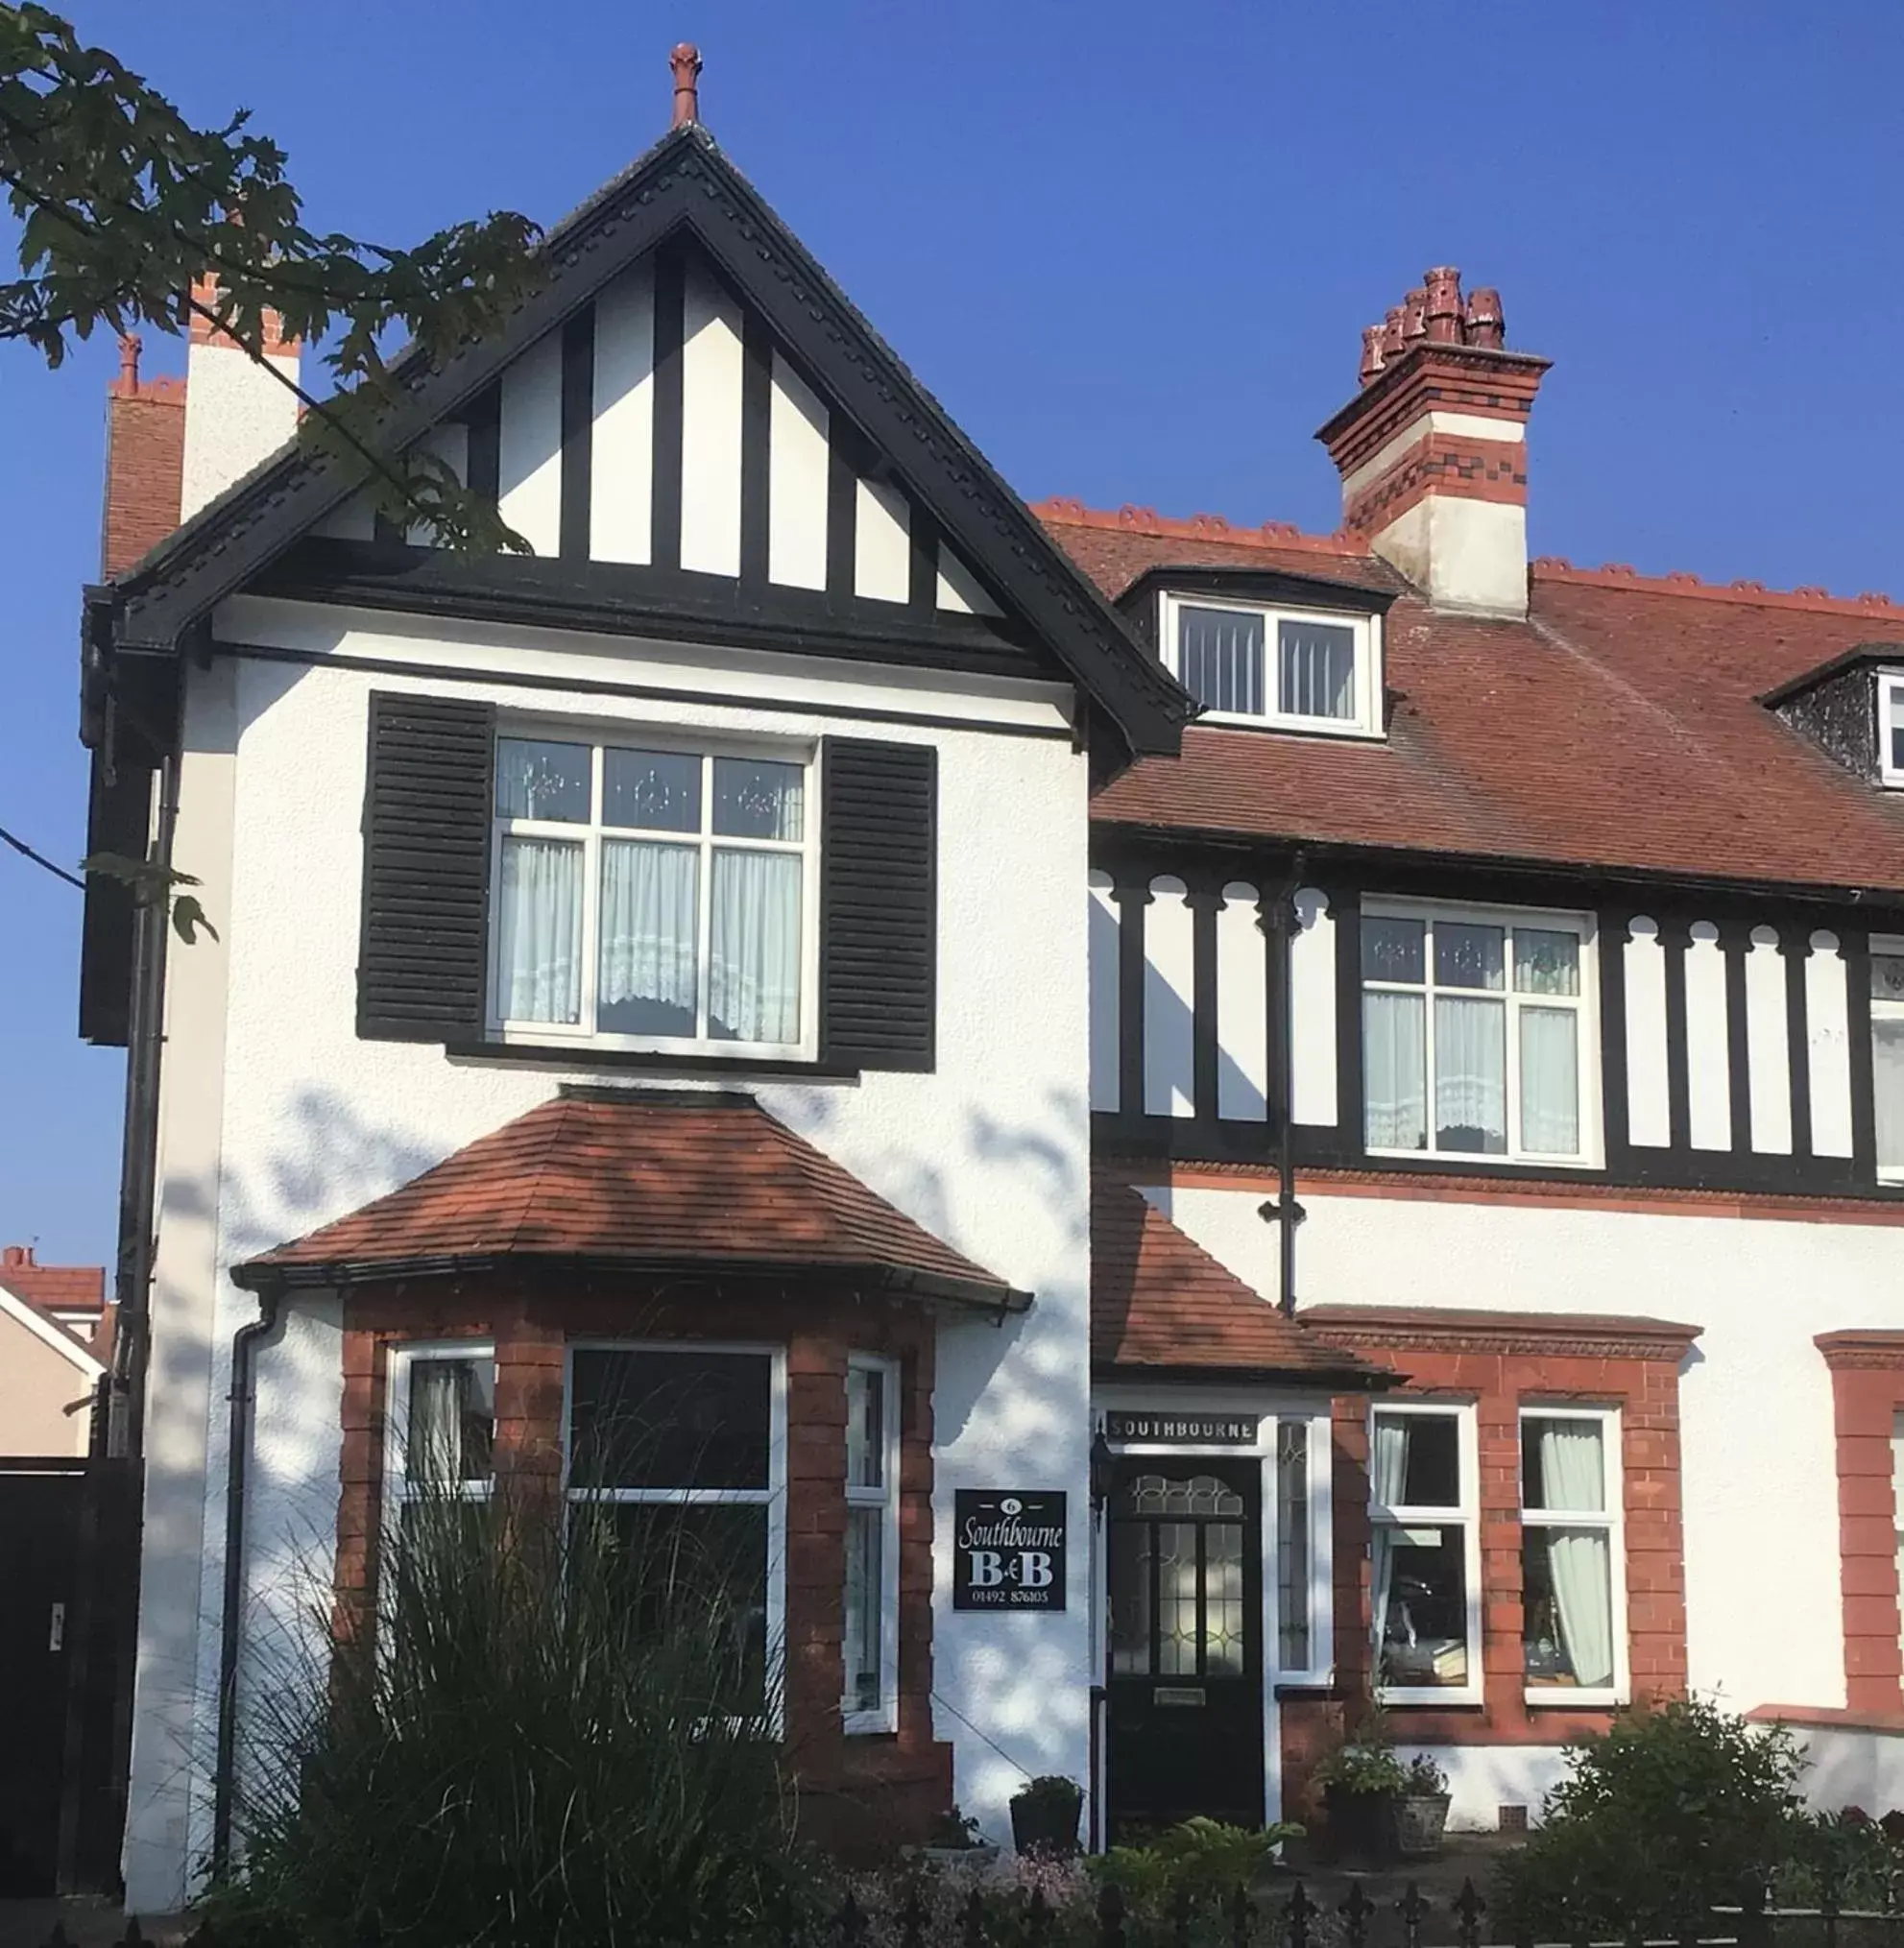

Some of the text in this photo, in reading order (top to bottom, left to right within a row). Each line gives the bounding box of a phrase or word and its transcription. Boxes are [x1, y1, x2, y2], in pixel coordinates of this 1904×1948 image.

[1111, 1420, 1252, 1438] SOUTHBOURNE
[959, 1516, 1063, 1549] Southbourne
[968, 1551, 1053, 1587] B&B
[973, 1591, 1005, 1602] 01492
